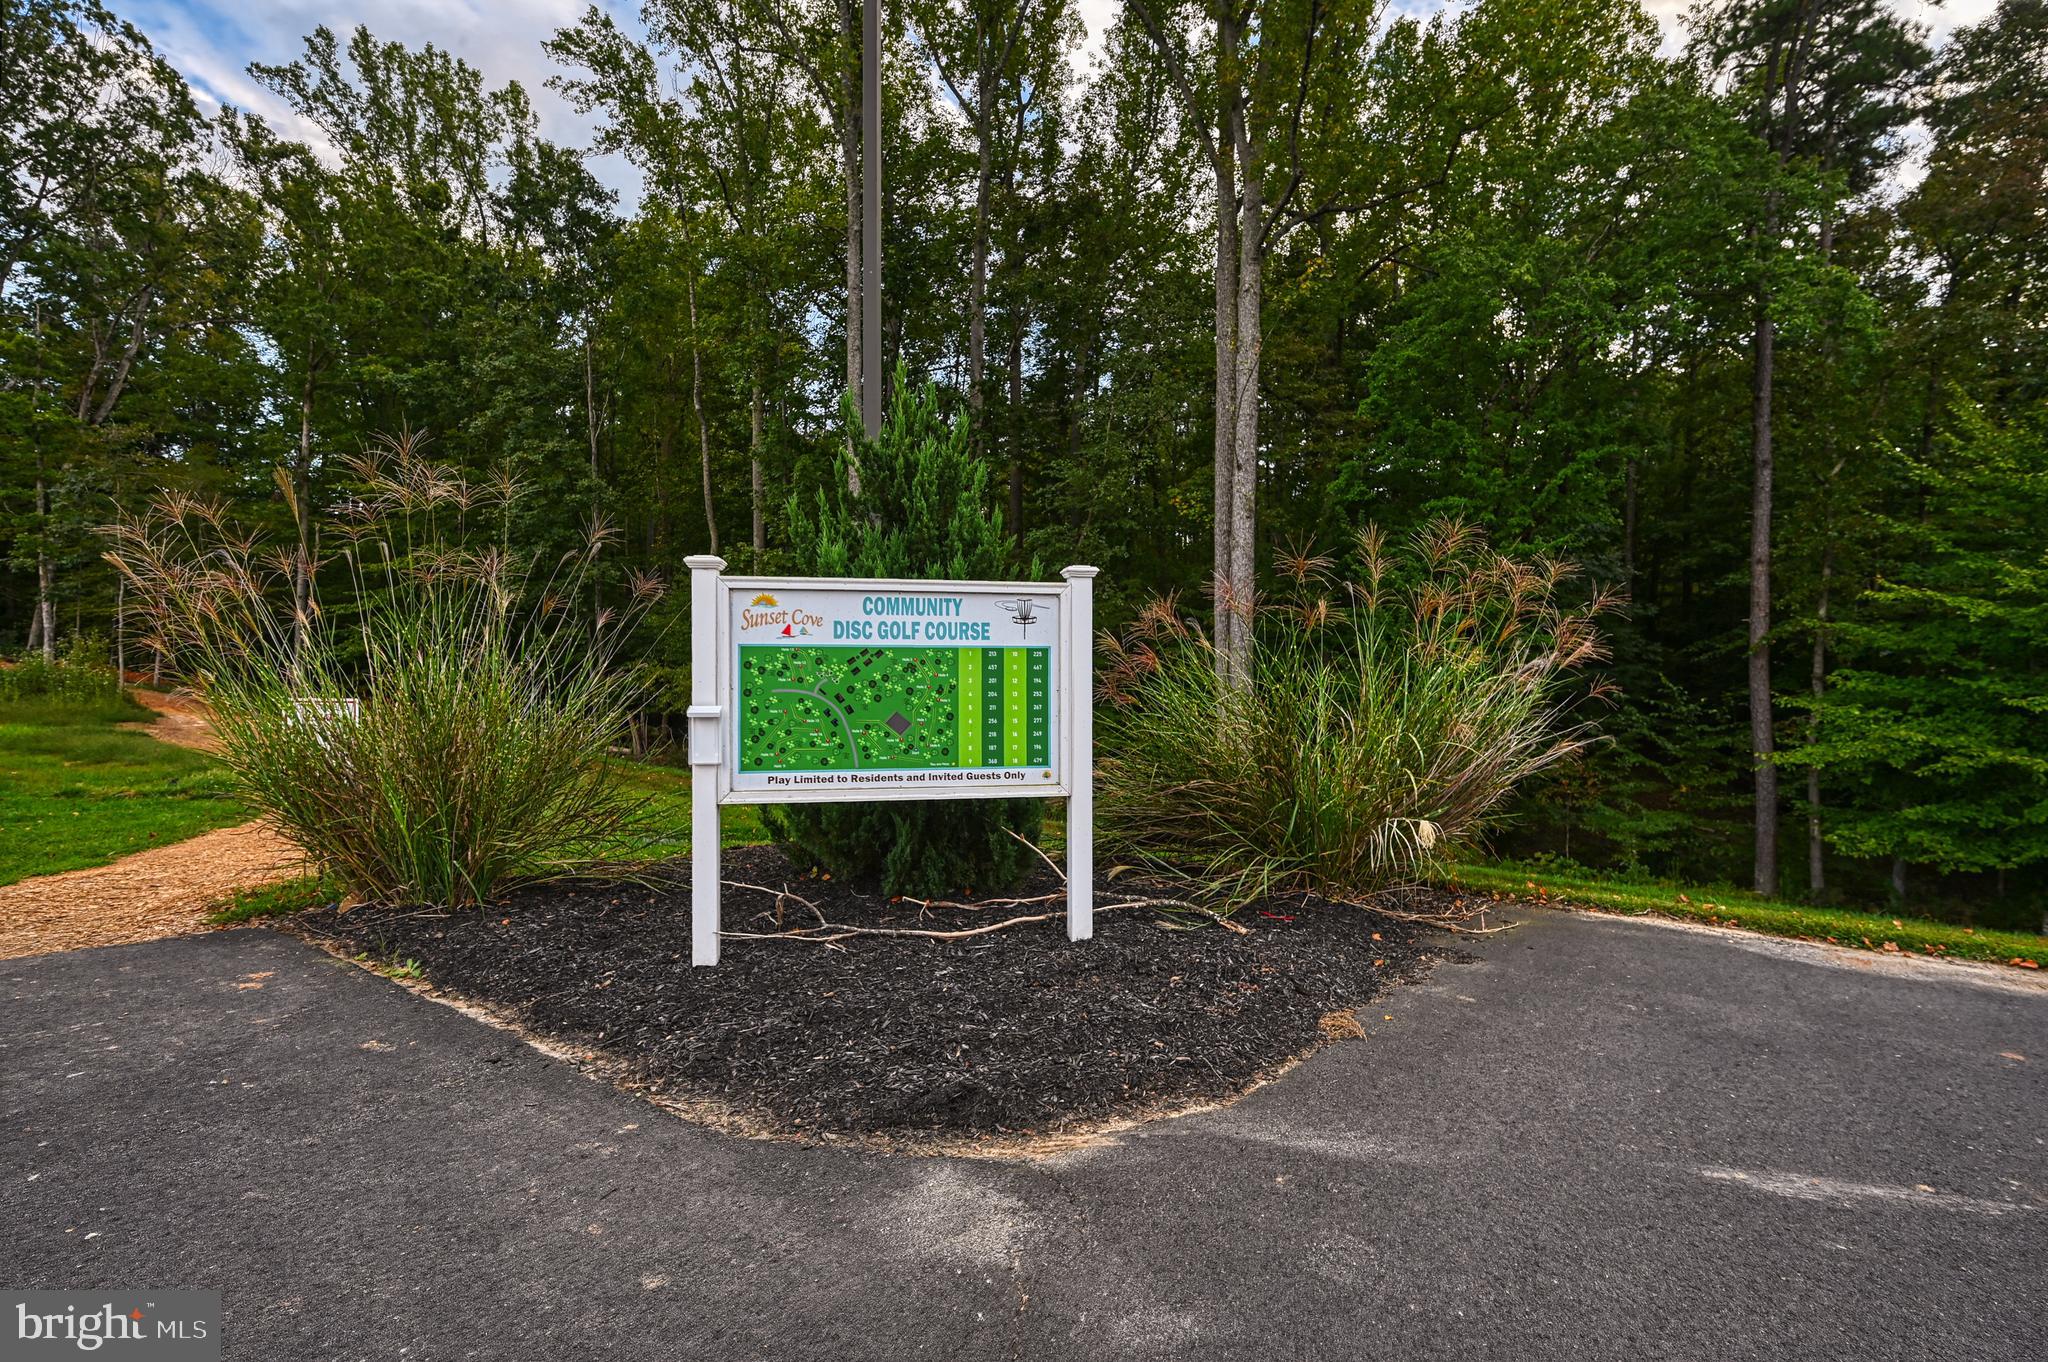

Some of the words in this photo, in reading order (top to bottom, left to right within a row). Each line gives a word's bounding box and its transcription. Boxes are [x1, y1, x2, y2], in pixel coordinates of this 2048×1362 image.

[862, 596, 963, 617] COMMUNITY
[741, 608, 788, 630] Sunset
[791, 608, 823, 627] Cove
[833, 620, 872, 640] DISC
[878, 621, 920, 640] GOLF
[925, 621, 990, 641] COURSE
[768, 776, 791, 786] Play
[794, 774, 834, 784] Limited
[837, 775, 848, 783] to
[851, 773, 904, 783] Residents
[907, 773, 925, 782] and
[929, 772, 964, 781] Invited
[966, 771, 1001, 781] Guests
[1004, 771, 1026, 780] Only
